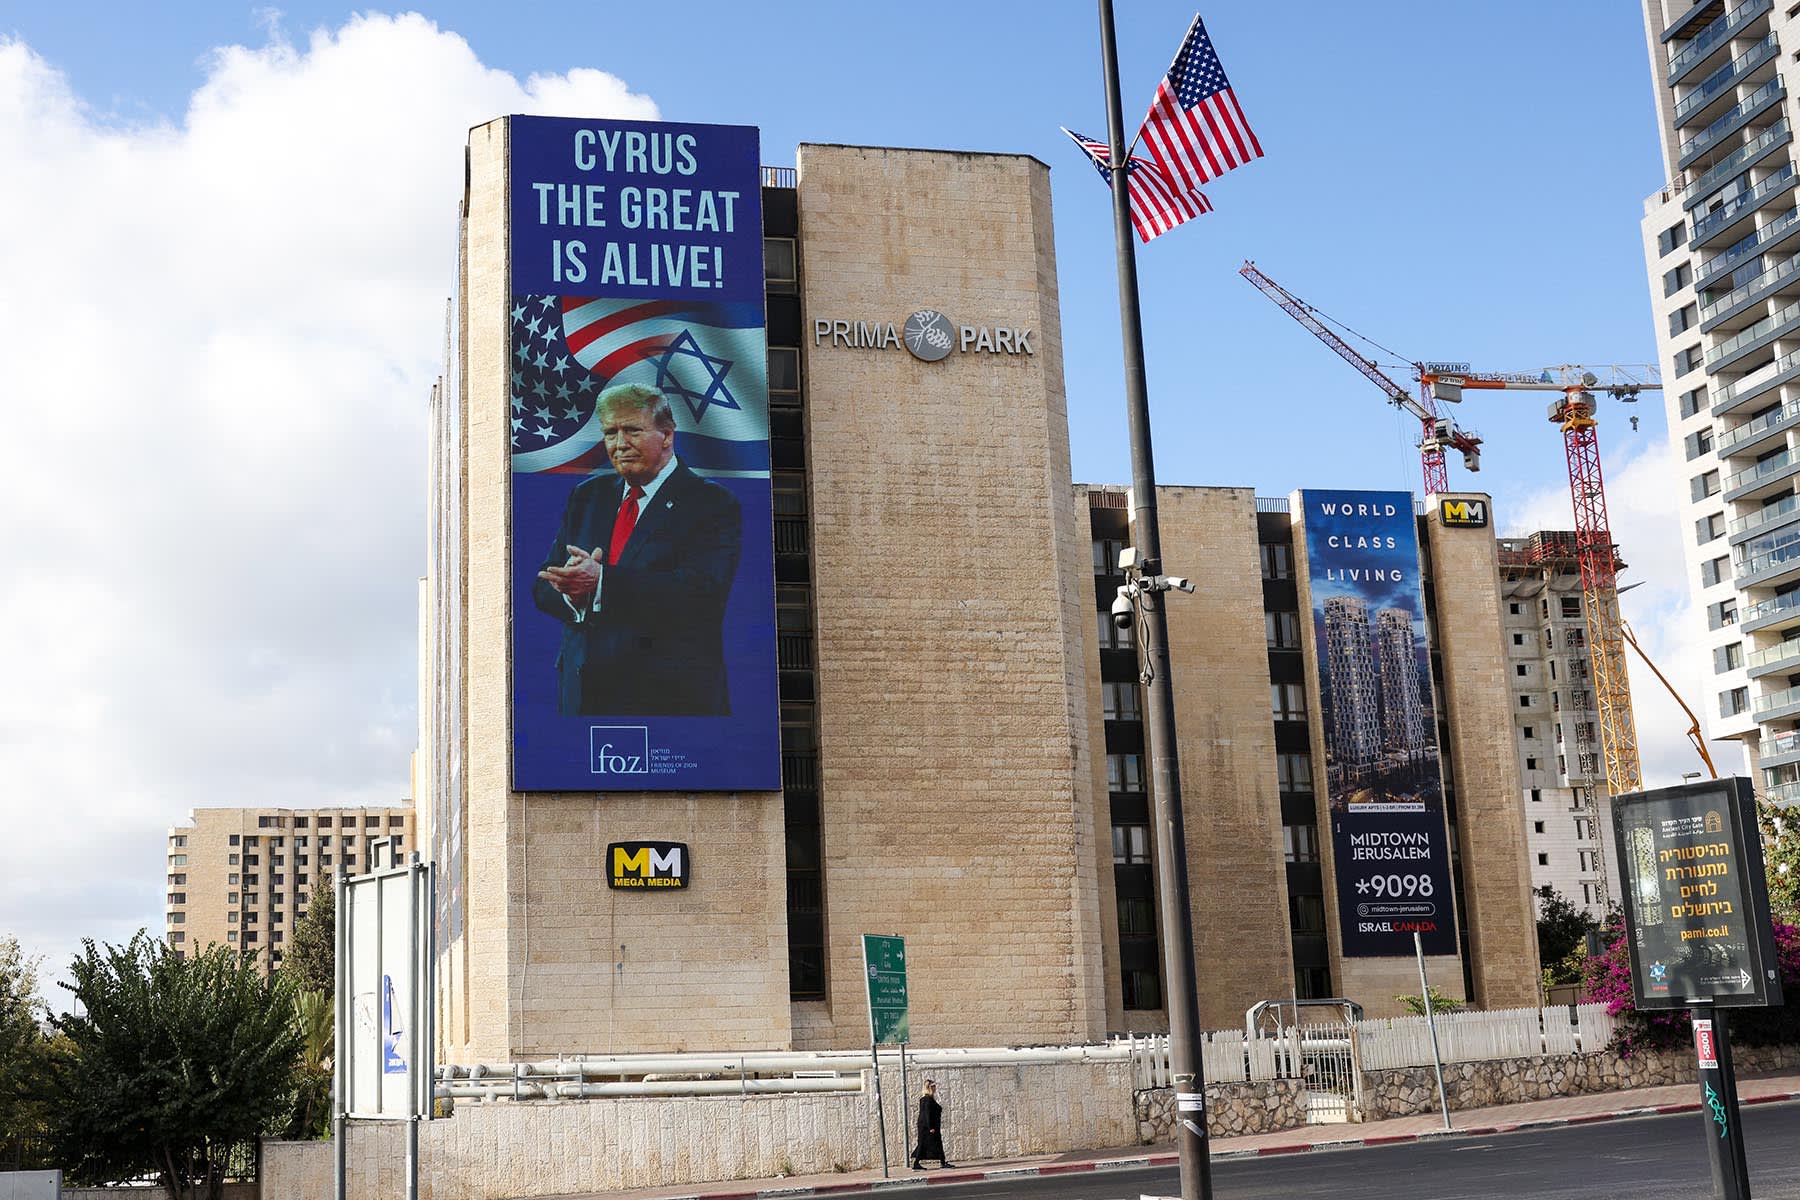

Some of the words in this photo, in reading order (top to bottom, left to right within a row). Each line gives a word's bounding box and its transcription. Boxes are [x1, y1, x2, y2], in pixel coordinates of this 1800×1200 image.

[574, 129, 697, 176] CYRUS
[532, 182, 606, 228] THE
[620, 186, 740, 233] GREAT
[552, 239, 587, 283] IS
[600, 241, 723, 289] ALIVE!
[814, 318, 900, 350] PRIMA
[960, 325, 1034, 354] PARK
[1428, 364, 1461, 372] POTAIN
[1321, 503, 1396, 517] WORLD
[1445, 501, 1483, 519] MM
[1328, 536, 1396, 549] CLASS
[1327, 568, 1402, 581] LIVING
[598, 743, 643, 774] foz
[1350, 832, 1429, 846] MIDTOWN
[1352, 847, 1431, 860] JERUSALEM
[1659, 842, 1729, 862] ההיסטוריה
[614, 847, 681, 877] MM
[1665, 861, 1728, 881] מתעוררת
[614, 878, 645, 887] MEGA
[648, 878, 682, 887] MEDIA
[1680, 882, 1718, 898] לחיים
[1671, 900, 1733, 918] בירושלים
[1359, 922, 1393, 932] ISRAEL
[1680, 926, 1729, 942] pami.co.il
